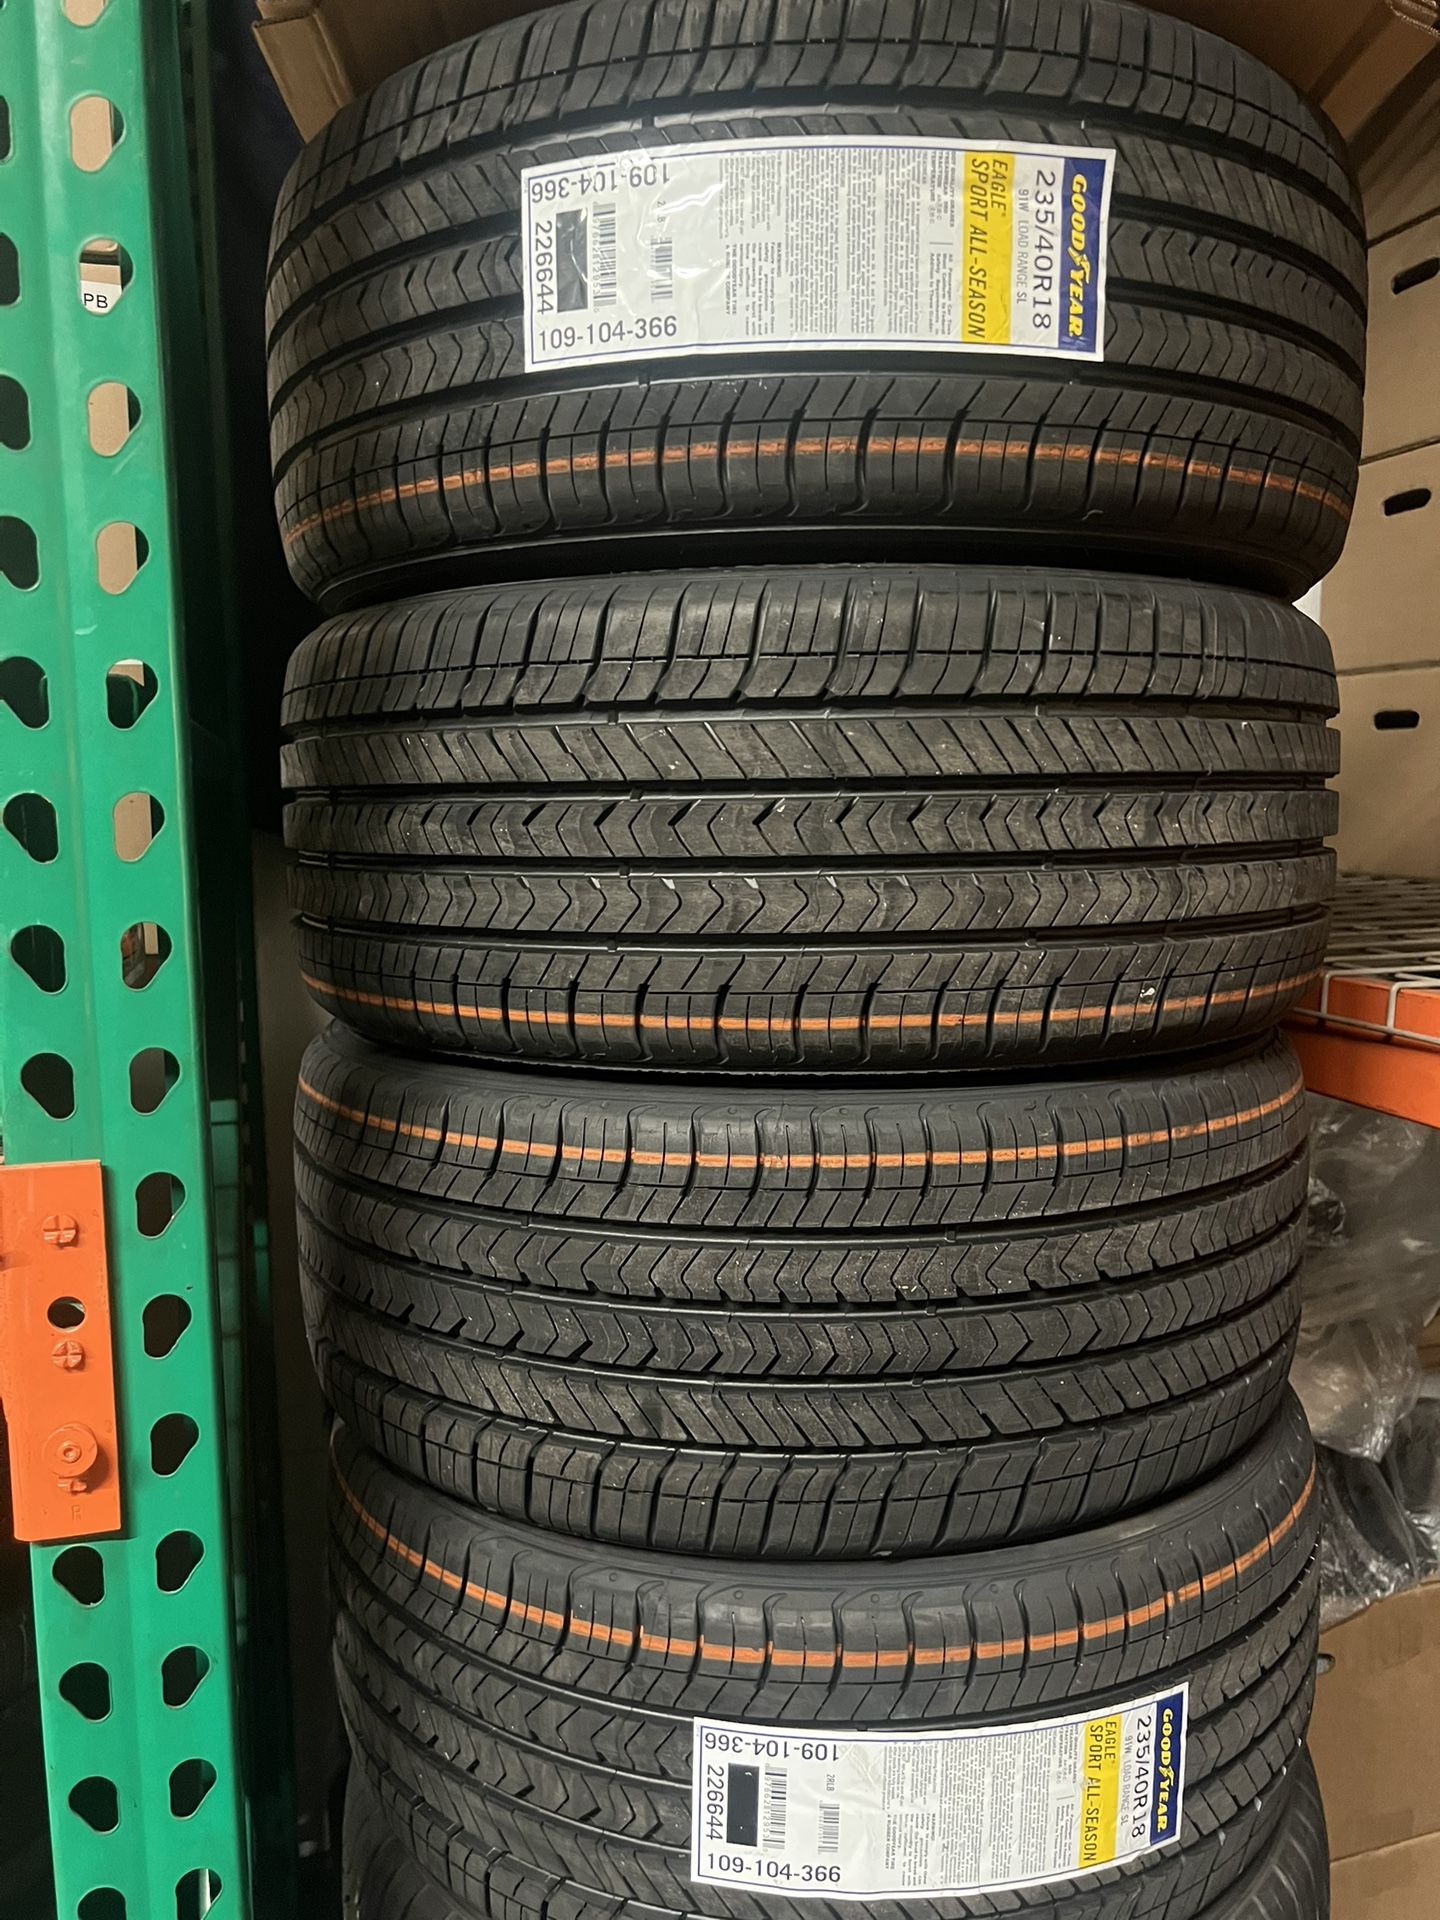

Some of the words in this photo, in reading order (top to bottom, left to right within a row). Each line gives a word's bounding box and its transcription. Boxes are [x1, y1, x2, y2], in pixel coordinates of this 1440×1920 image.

[532, 163, 669, 203] 109-104-366
[970, 158, 989, 222] SPORT
[1018, 189, 1030, 212] 91W
[1017, 220, 1029, 247] LOAD
[1032, 170, 1055, 329] 235/40R18
[535, 221, 553, 314] 226644
[1016, 252, 1028, 287] RANGE
[1067, 174, 1090, 337] GOODYEAR
[968, 225, 987, 339] ALL-SEASON
[1016, 292, 1027, 304] SL
[83, 293, 108, 308] PB
[539, 315, 677, 350] 109-104-366
[705, 1732, 839, 1762] 109-104-366
[1088, 1725, 1103, 1771] SPORT
[1124, 1736, 1133, 1754] 91W
[1123, 1760, 1131, 1782] LOAD
[1131, 1715, 1151, 1838] 235/40R18
[1157, 1708, 1174, 1832] GOODYEAR
[706, 1764, 725, 1840] 226644
[1122, 1784, 1130, 1811] RANGE
[1084, 1777, 1101, 1861] ALL-SEASON
[1121, 1815, 1129, 1826] SL
[708, 1853, 841, 1883] 109-104-366
